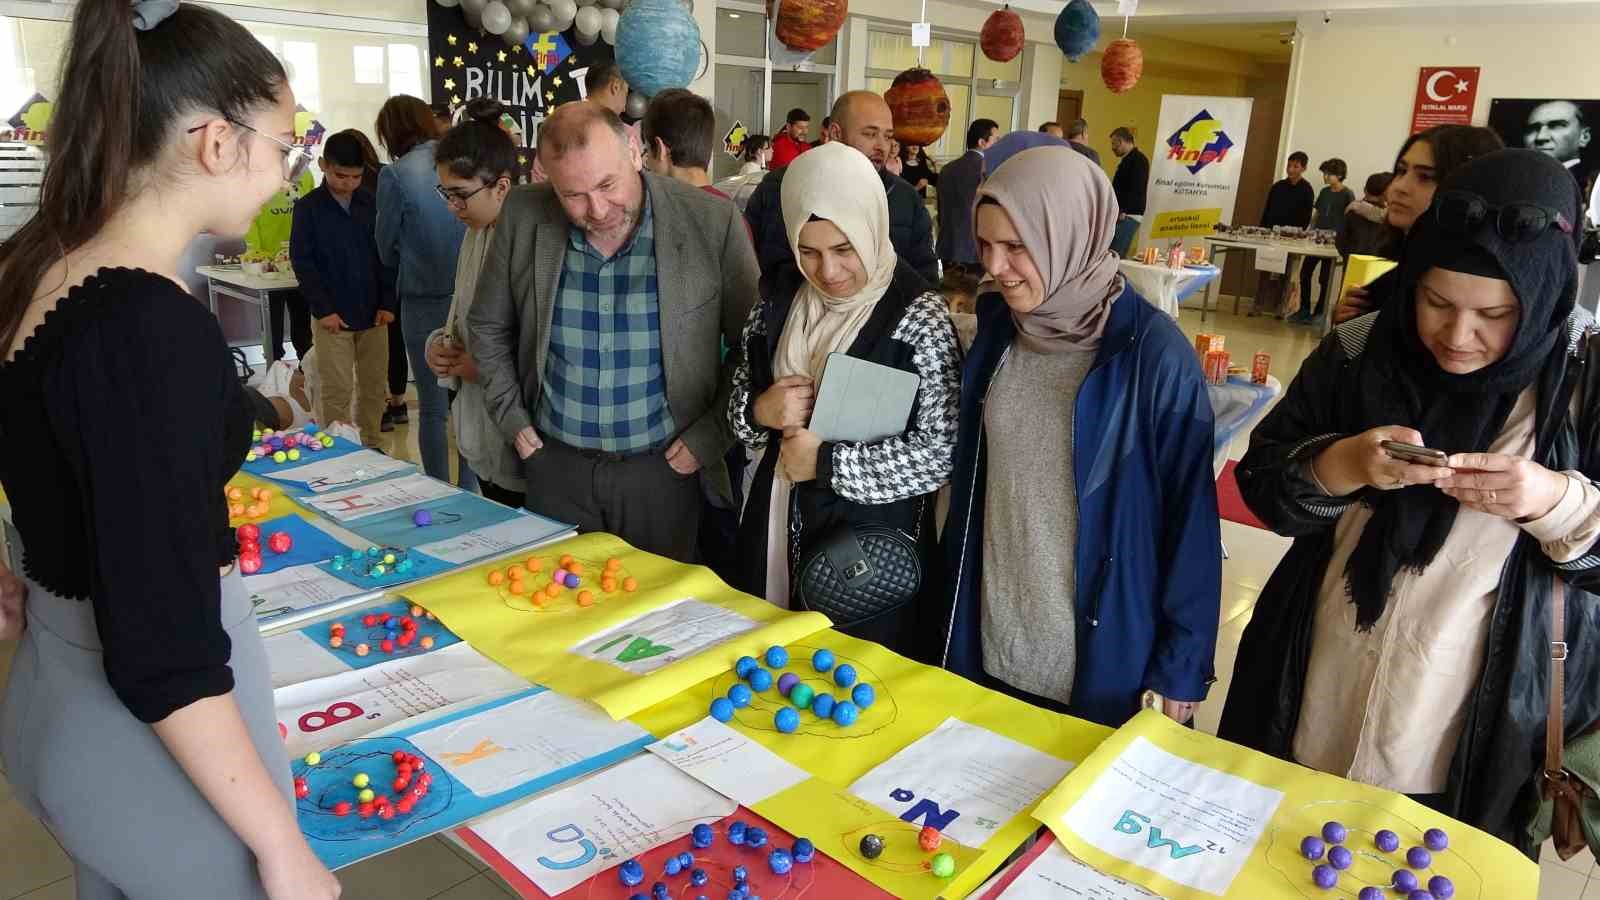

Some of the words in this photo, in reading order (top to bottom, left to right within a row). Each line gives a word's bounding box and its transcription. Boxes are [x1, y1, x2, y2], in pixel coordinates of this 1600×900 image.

[465, 61, 544, 106] BİLİM
[1167, 144, 1229, 164] final
[298, 702, 364, 732] B
[1113, 809, 1207, 860] Mg
